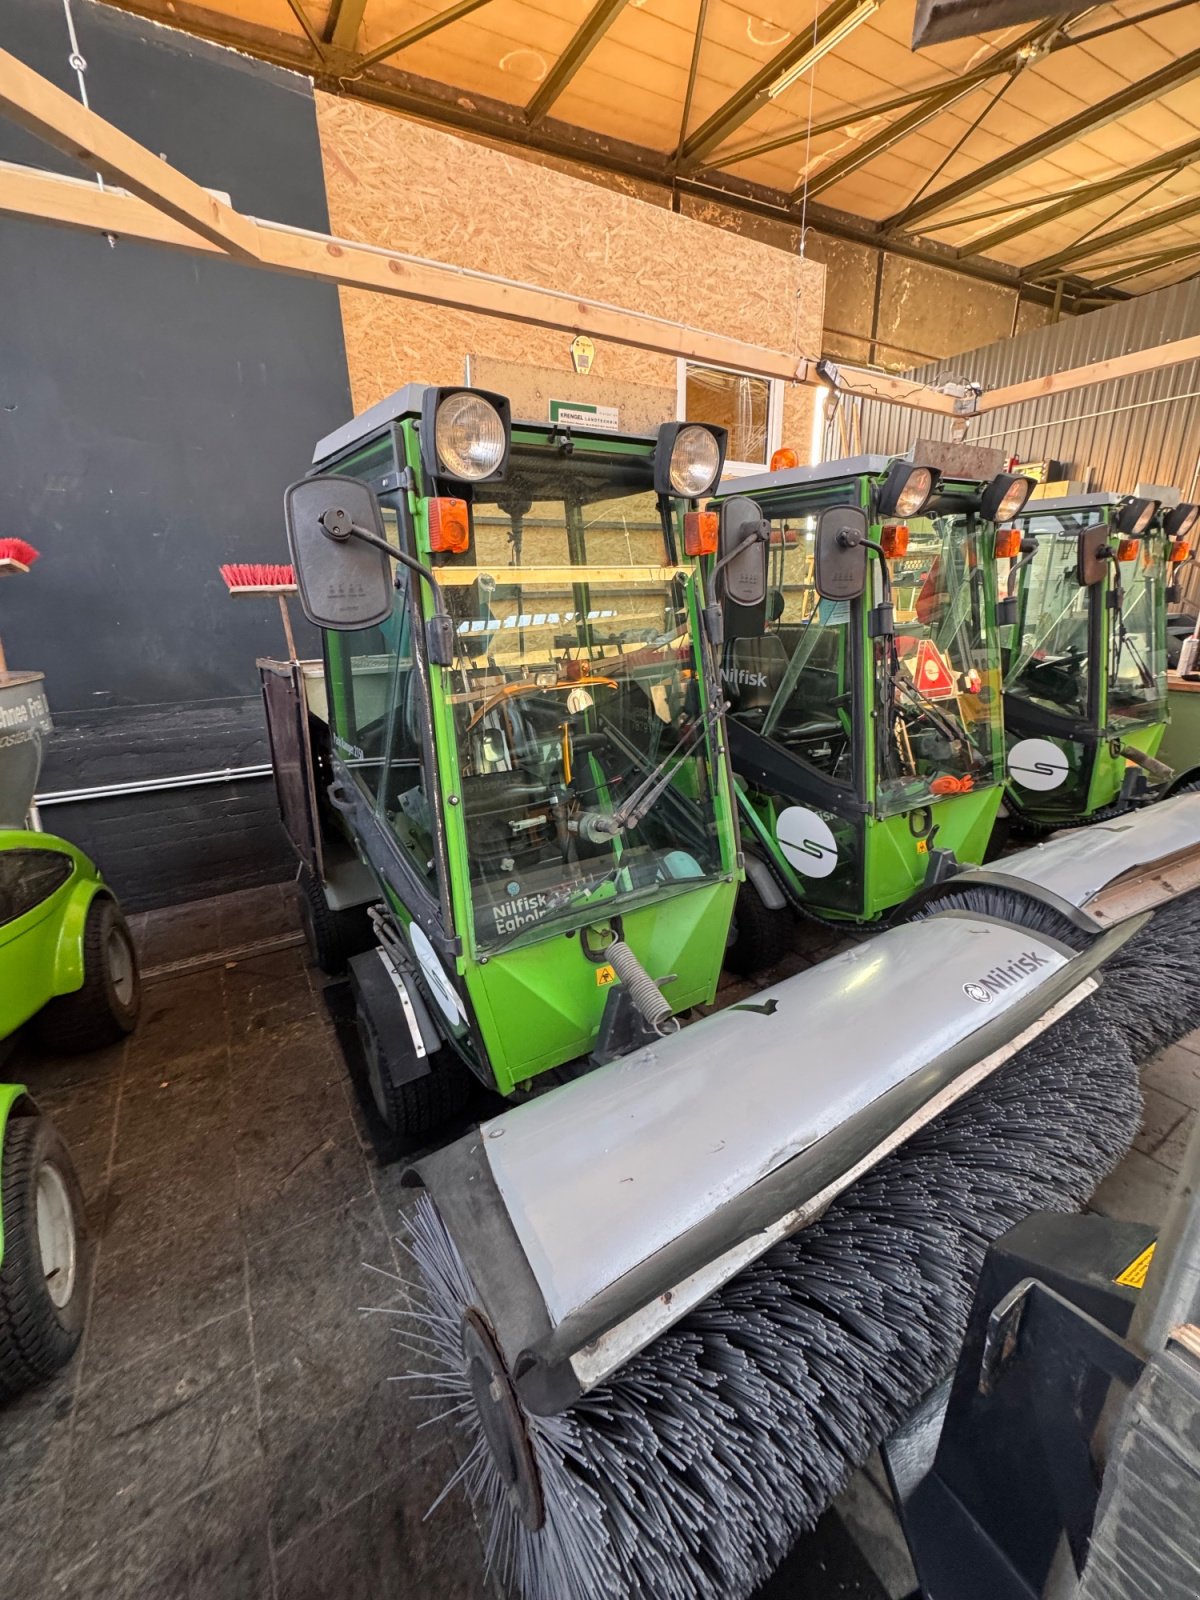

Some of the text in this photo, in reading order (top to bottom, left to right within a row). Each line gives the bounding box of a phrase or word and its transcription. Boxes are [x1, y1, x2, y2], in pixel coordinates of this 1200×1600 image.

[560, 412, 584, 421] KRENGEL
[720, 668, 768, 688] Nilfisk
[492, 893, 547, 919] Nilfisk
